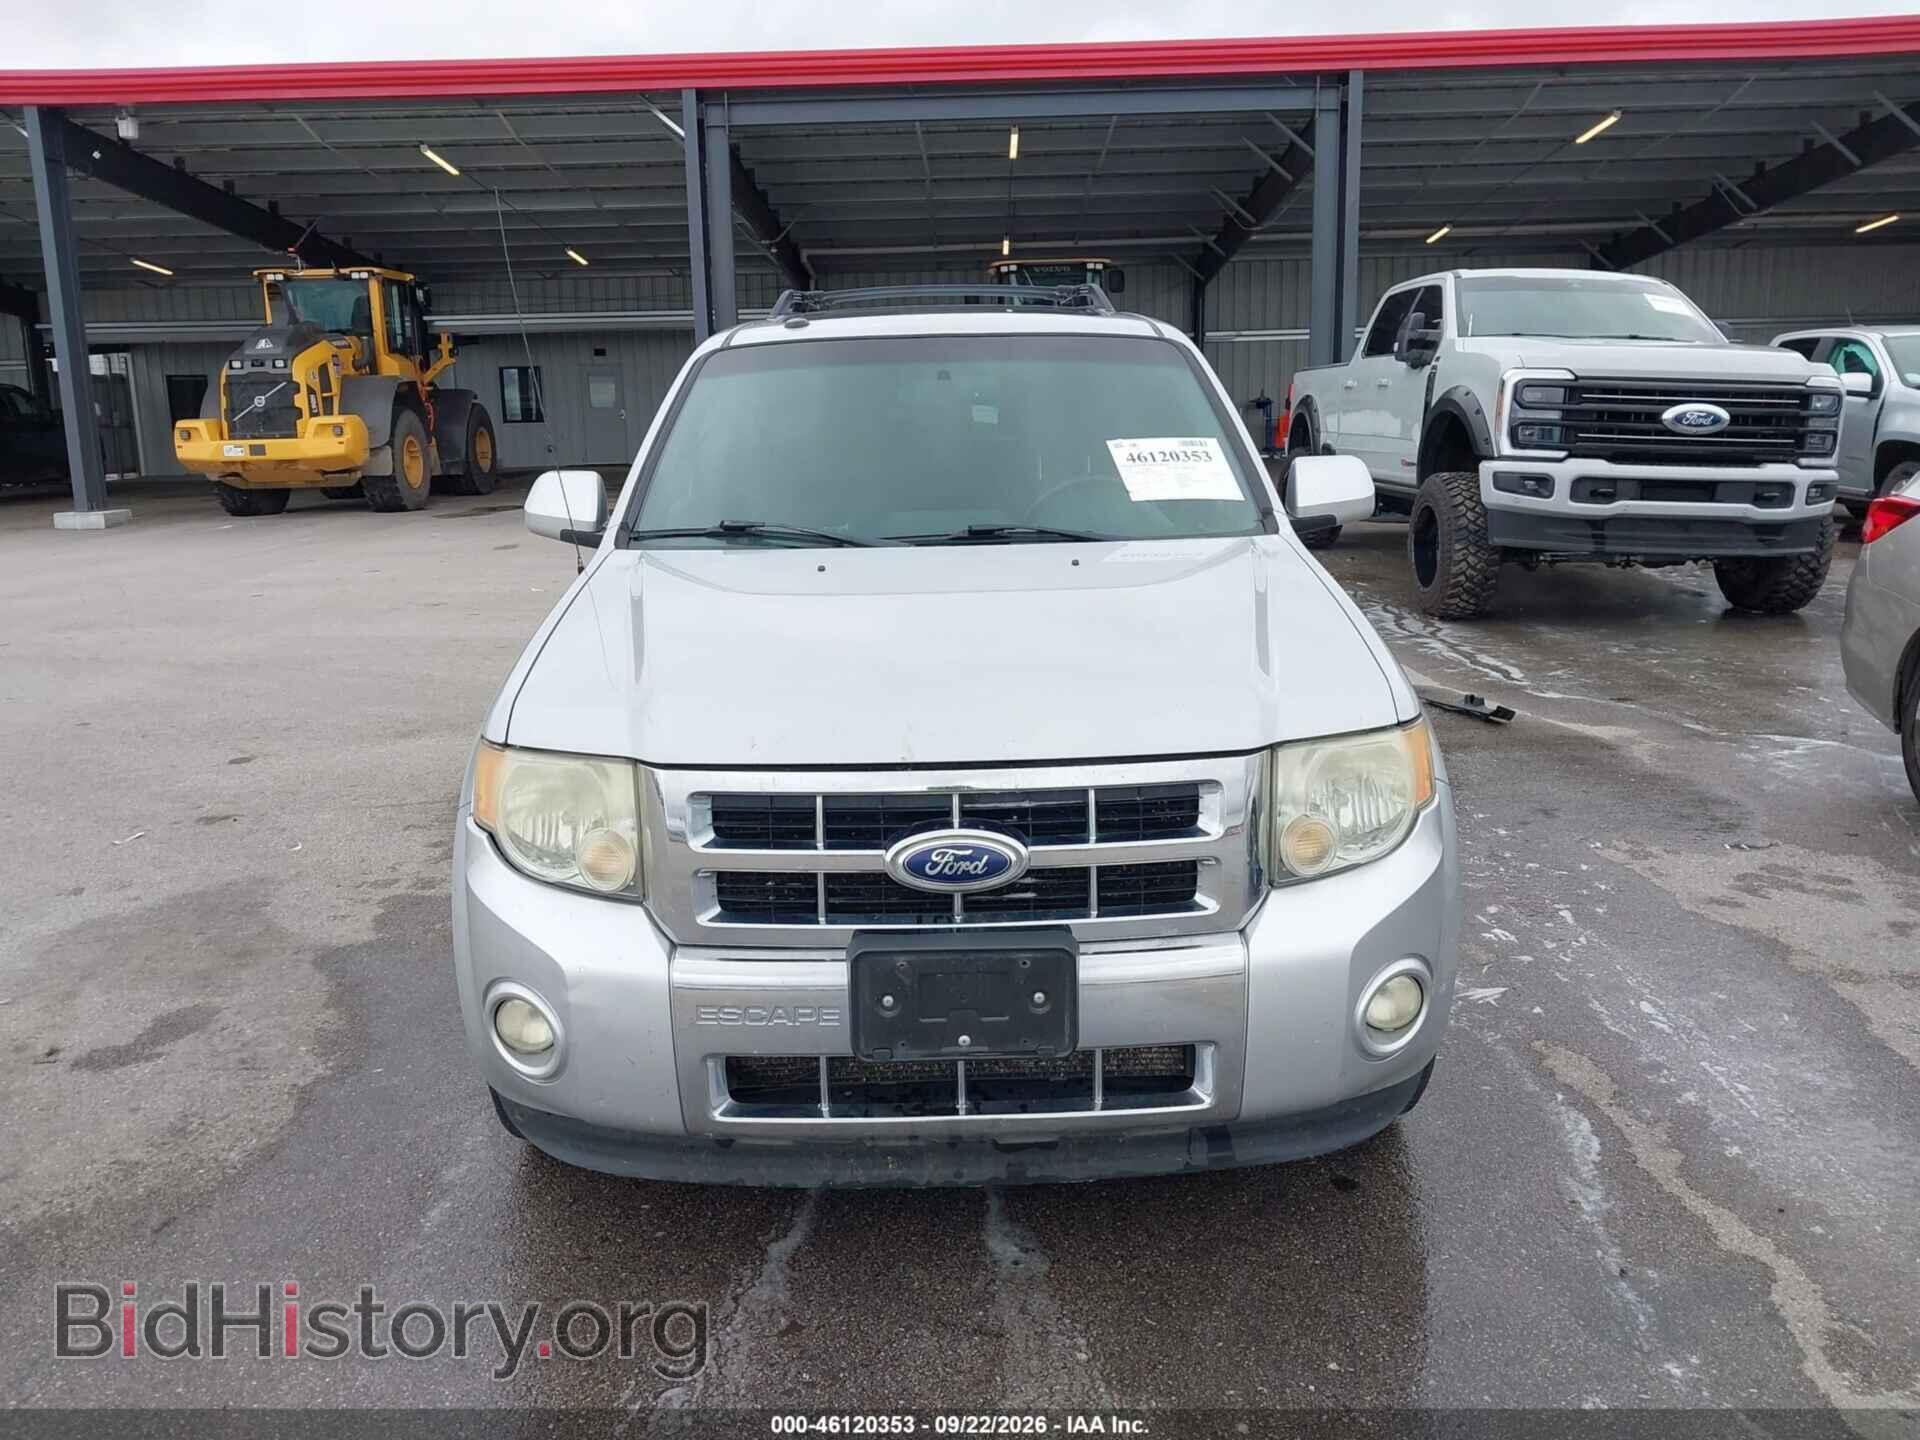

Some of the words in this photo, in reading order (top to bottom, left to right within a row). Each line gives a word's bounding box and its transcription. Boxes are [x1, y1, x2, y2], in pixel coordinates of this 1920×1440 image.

[1682, 411, 1714, 425] Ford
[1126, 450, 1213, 464] 46120353
[925, 848, 988, 876] Ford
[696, 1006, 841, 1026] ESCAPE
